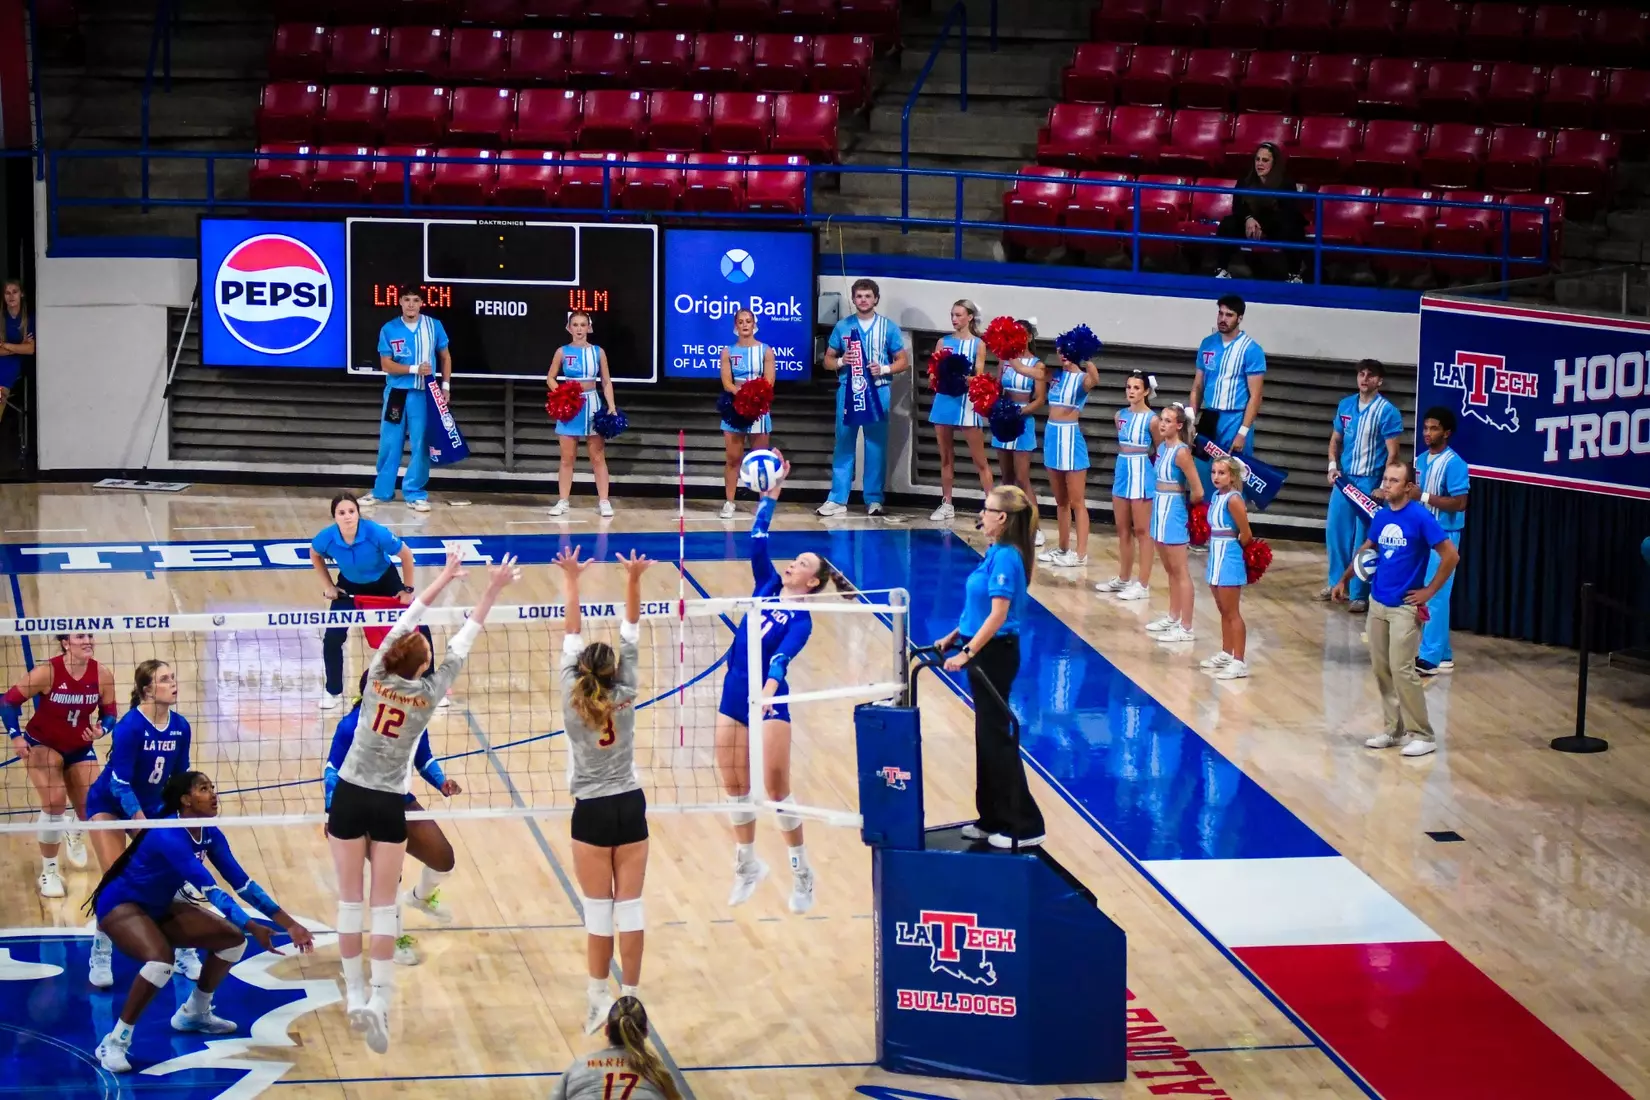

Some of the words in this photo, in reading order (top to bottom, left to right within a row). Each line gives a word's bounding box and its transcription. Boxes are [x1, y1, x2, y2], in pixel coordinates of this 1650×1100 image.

[221, 281, 328, 308] PEPSI
[569, 289, 608, 311] ULM
[475, 300, 528, 316] PERIOD
[674, 294, 741, 320] Origin
[749, 295, 802, 316] Bank
[682, 344, 704, 354] THE
[771, 347, 795, 357] ANK
[673, 358, 690, 368] OF
[693, 359, 707, 369] LA
[774, 360, 803, 371] ETICS
[1535, 408, 1650, 462] TROO
[20, 540, 493, 570] TECH
[268, 610, 366, 626] LOUISIANA
[375, 609, 406, 622] TE
[518, 604, 615, 619] LOUISANA
[624, 602, 669, 615] ECH
[15, 617, 113, 632] LOUISIANA
[123, 616, 170, 629] TECH
[50, 692, 83, 704] LOUISIANA
[67, 709, 80, 727] 4
[372, 703, 405, 739] 12
[144, 740, 155, 750] LA
[158, 740, 176, 751] TECH
[148, 756, 165, 784] 8
[897, 989, 1017, 1017] BULLDOGS
[587, 1058, 625, 1068] WARH
[603, 1072, 639, 1100] 17
